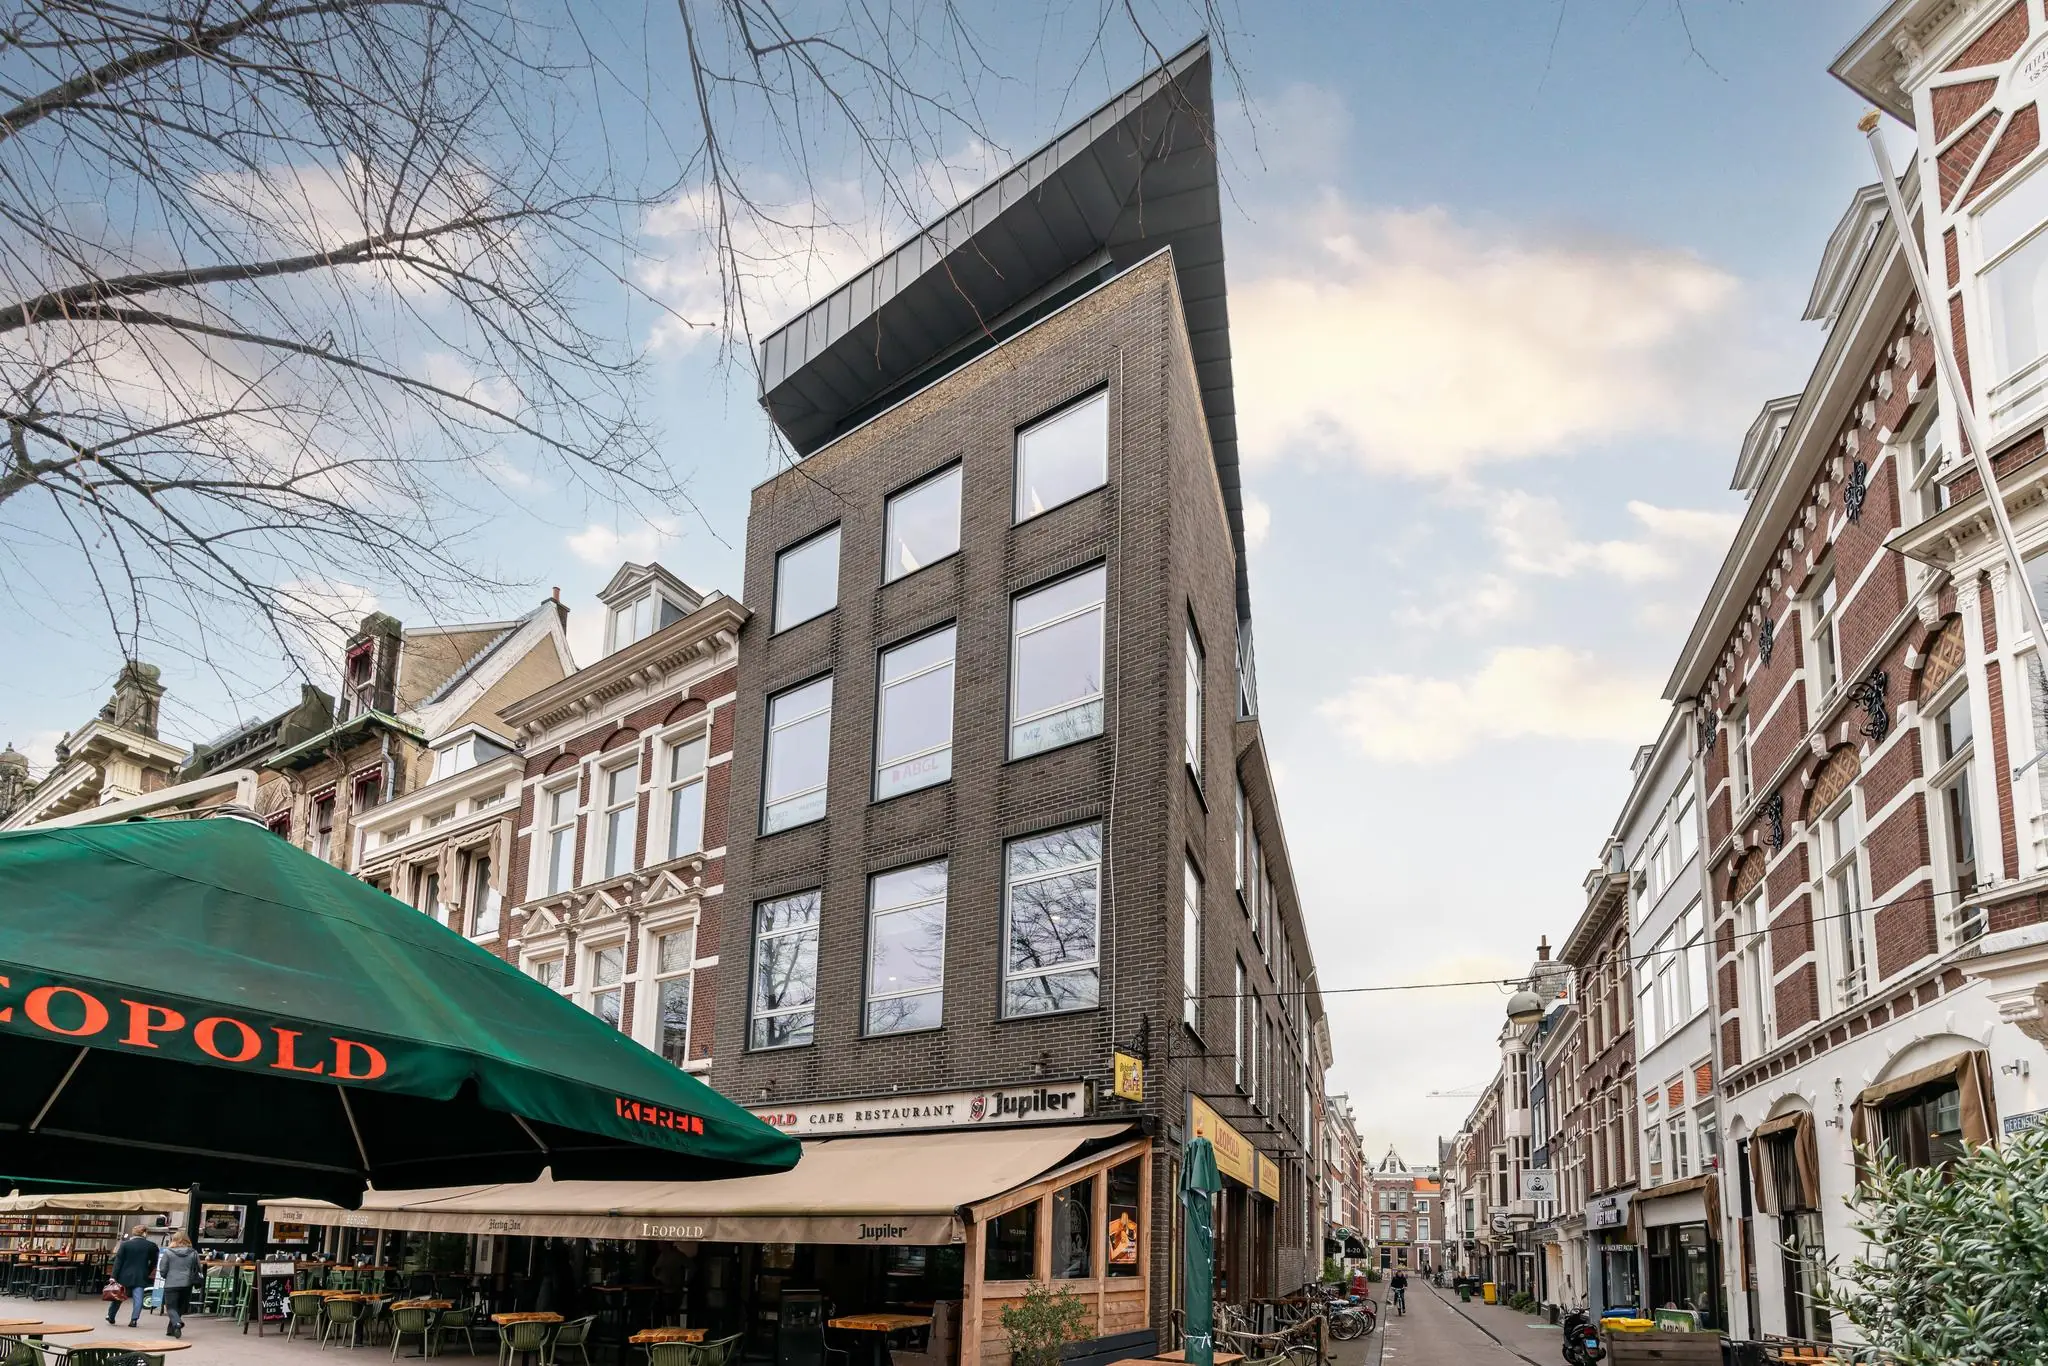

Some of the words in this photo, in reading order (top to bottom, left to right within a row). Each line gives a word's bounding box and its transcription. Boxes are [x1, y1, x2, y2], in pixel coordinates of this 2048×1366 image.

[0, 975, 388, 1080] OPOLD
[616, 1096, 704, 1136] KEREL
[855, 1104, 955, 1122] RESTAURANT
[988, 1088, 1077, 1119] Jupiler
[1214, 1119, 1240, 1159] LEOPOLD
[642, 1223, 704, 1238] LEOPOLD
[857, 1222, 908, 1242] Jupiler
